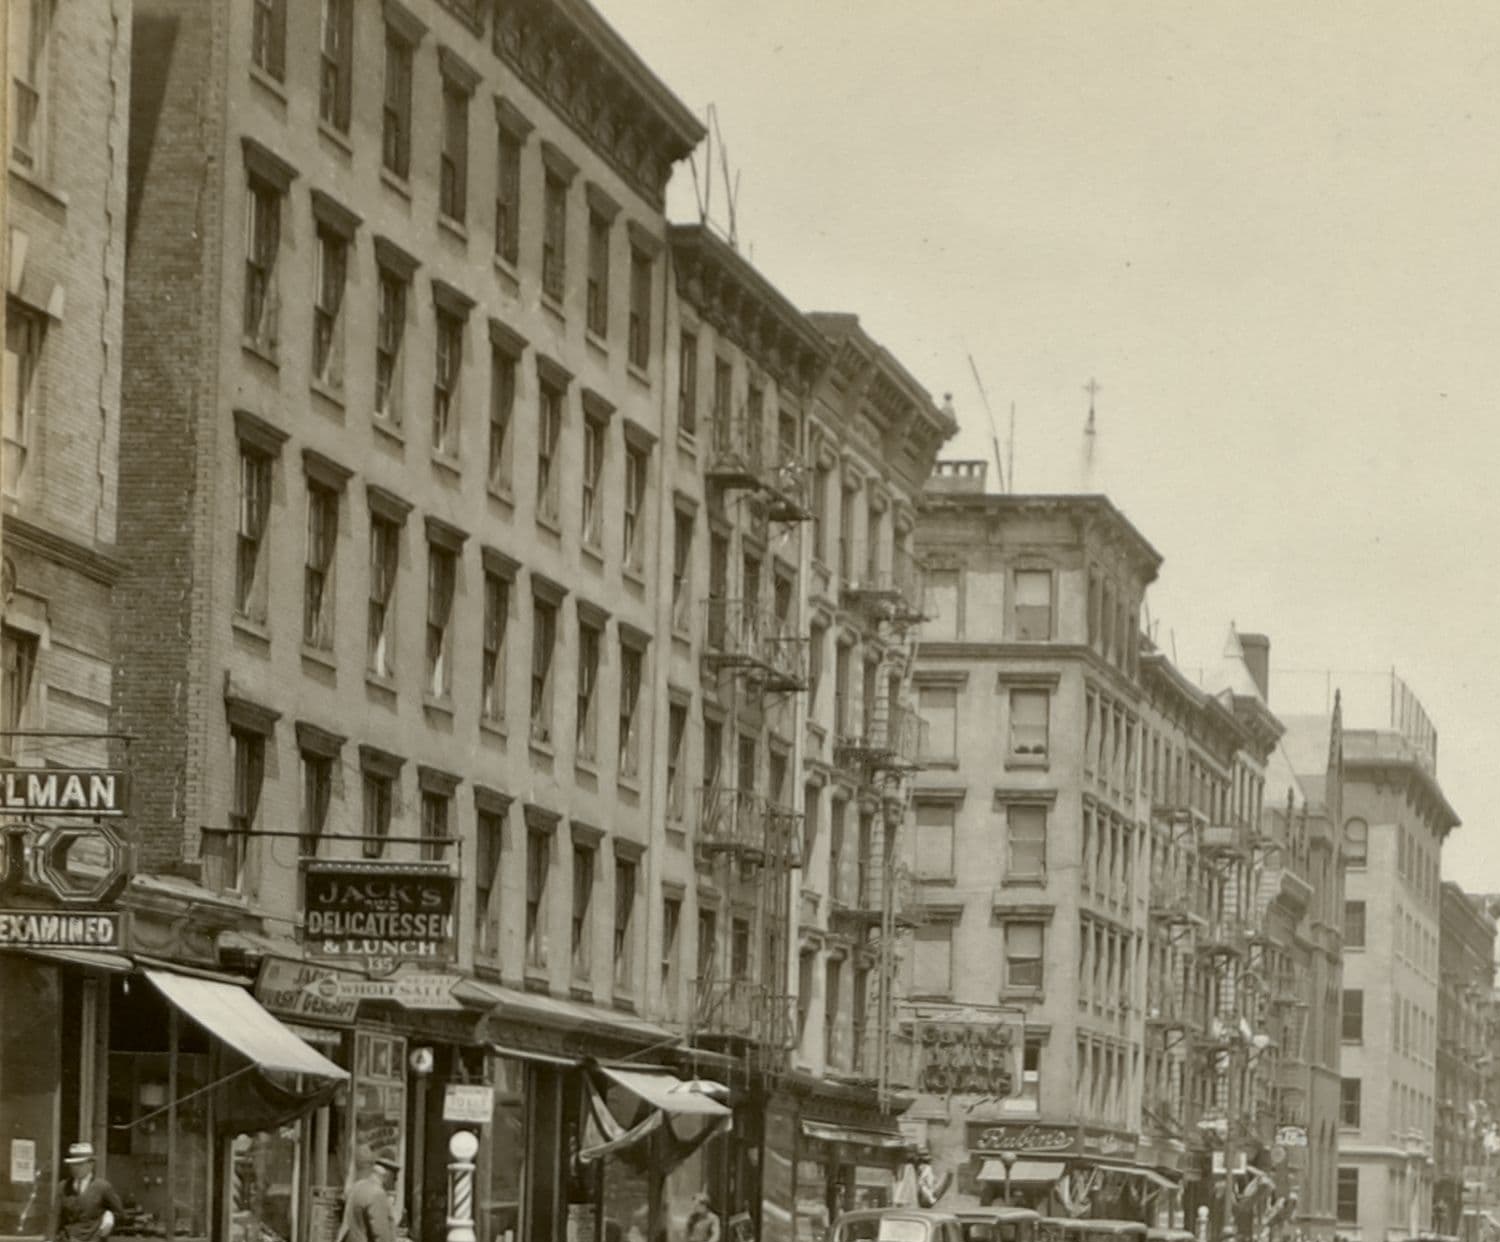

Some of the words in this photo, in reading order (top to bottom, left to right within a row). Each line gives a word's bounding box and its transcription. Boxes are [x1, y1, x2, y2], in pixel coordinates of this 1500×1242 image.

[0, 774, 115, 808] LMAN
[319, 881, 441, 906] JACK'S
[0, 915, 113, 943] EXAMINED
[308, 911, 453, 938] DELICATESSEN
[323, 940, 340, 953] &
[347, 940, 437, 955] LUNCH
